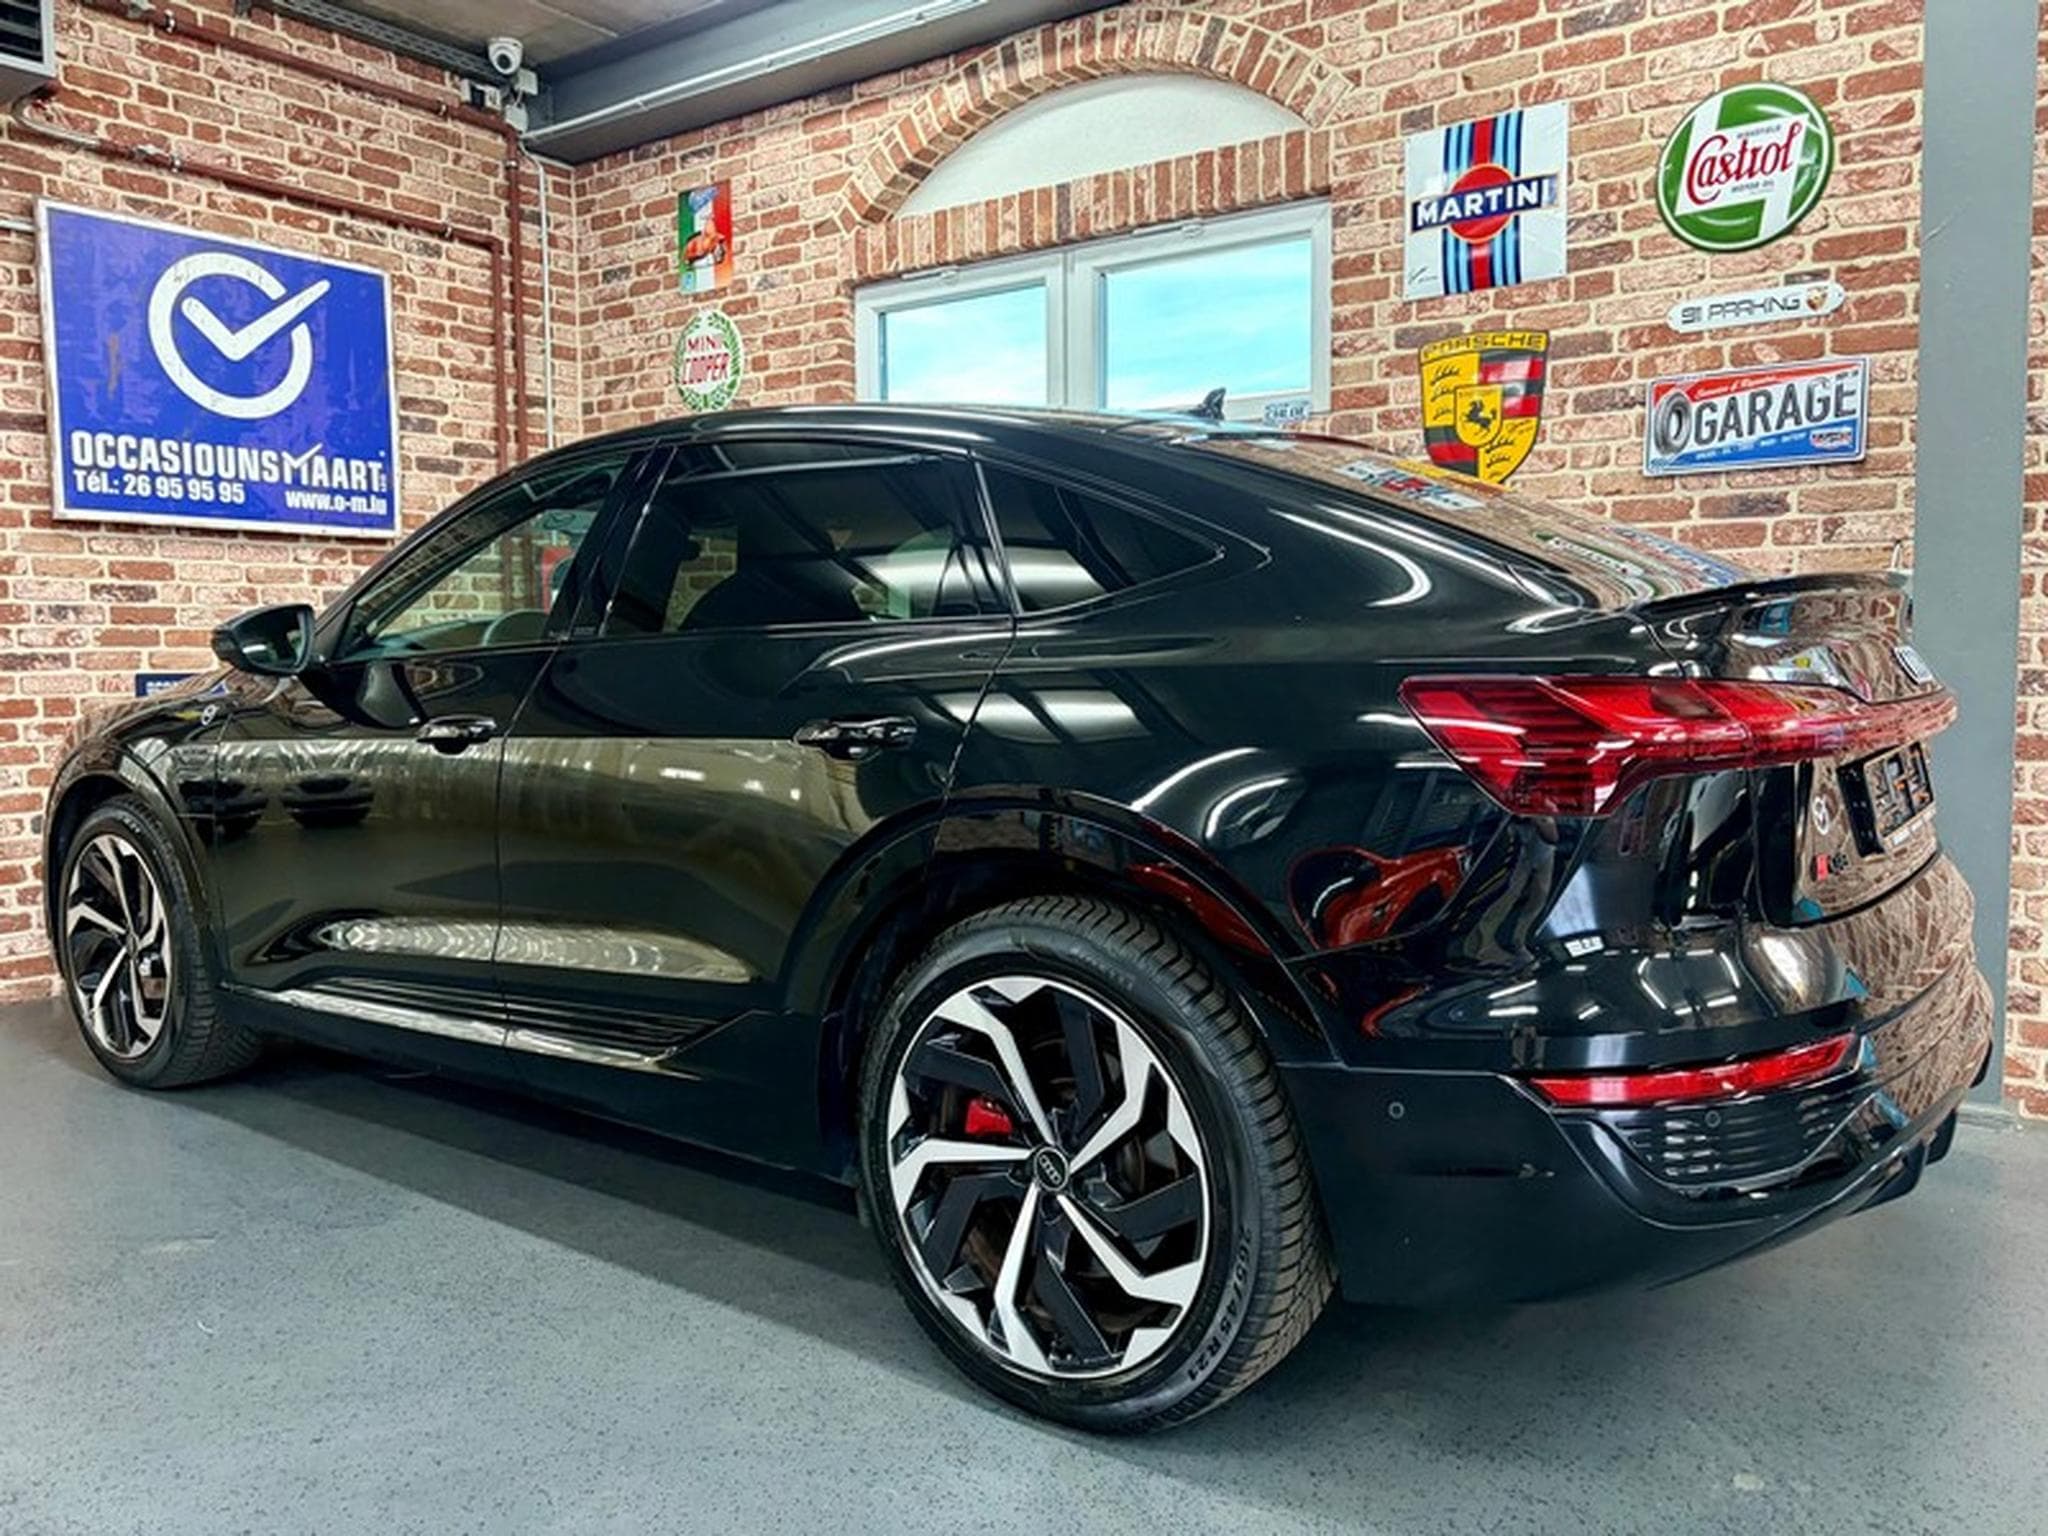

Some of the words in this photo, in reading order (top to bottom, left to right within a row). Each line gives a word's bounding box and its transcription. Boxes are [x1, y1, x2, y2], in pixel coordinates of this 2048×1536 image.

[1686, 121, 1803, 206] Castrol
[1416, 178, 1550, 227] MARTINI
[1707, 295, 1800, 321] PARKING
[682, 352, 729, 385] COOPER
[1693, 368, 1858, 446] GARAGE
[122, 473, 152, 498] 26
[155, 475, 184, 500] 95
[188, 478, 216, 502] 95
[218, 481, 246, 504] 95
[285, 490, 388, 516] www.o-m.lu
[1187, 1335, 1222, 1382] R21
